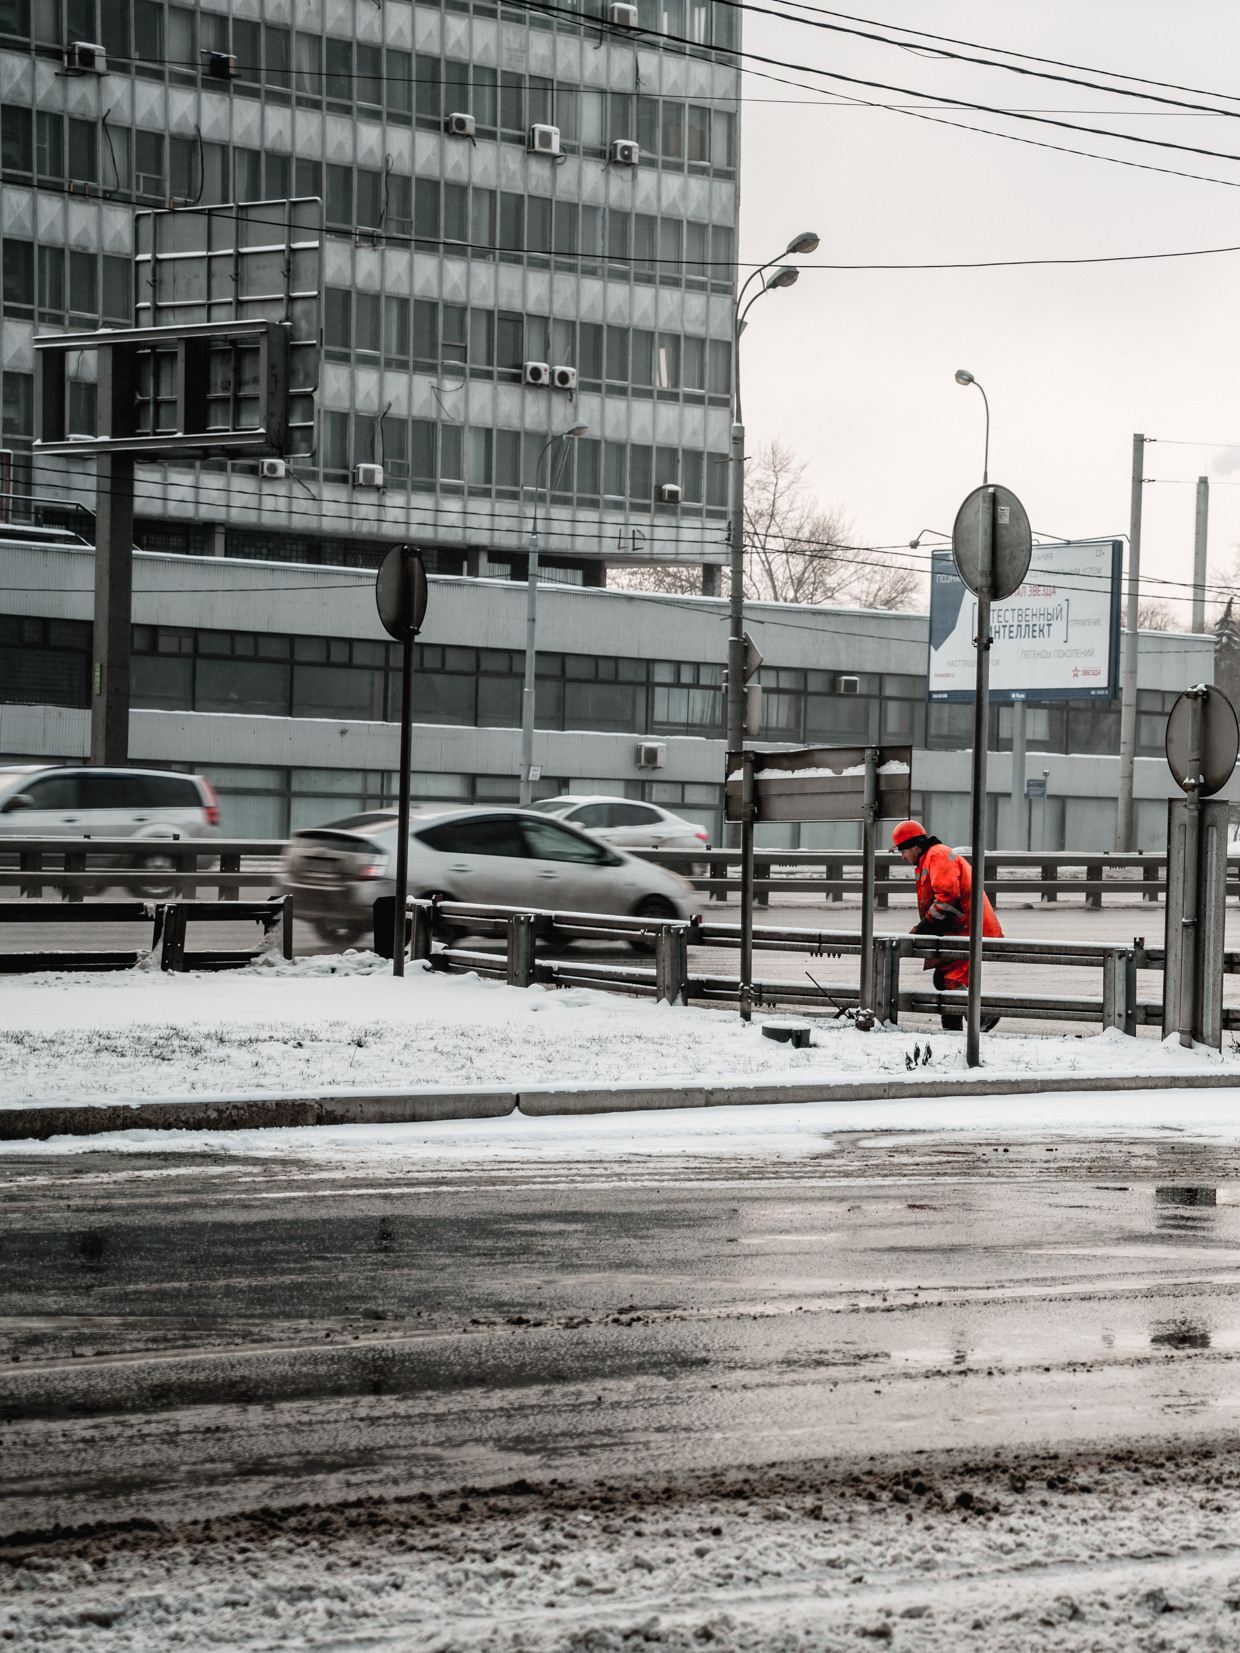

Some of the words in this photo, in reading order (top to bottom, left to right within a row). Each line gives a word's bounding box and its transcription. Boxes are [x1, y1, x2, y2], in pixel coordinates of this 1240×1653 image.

[1028, 584, 1056, 598] ЗВЕЗДА
[990, 603, 1063, 624] ТЕСТВЕННЫЙ
[1020, 649, 1053, 660] ЛЕГЕНДЫ
[1053, 646, 1095, 659] ПОКОЛЕНИЙ
